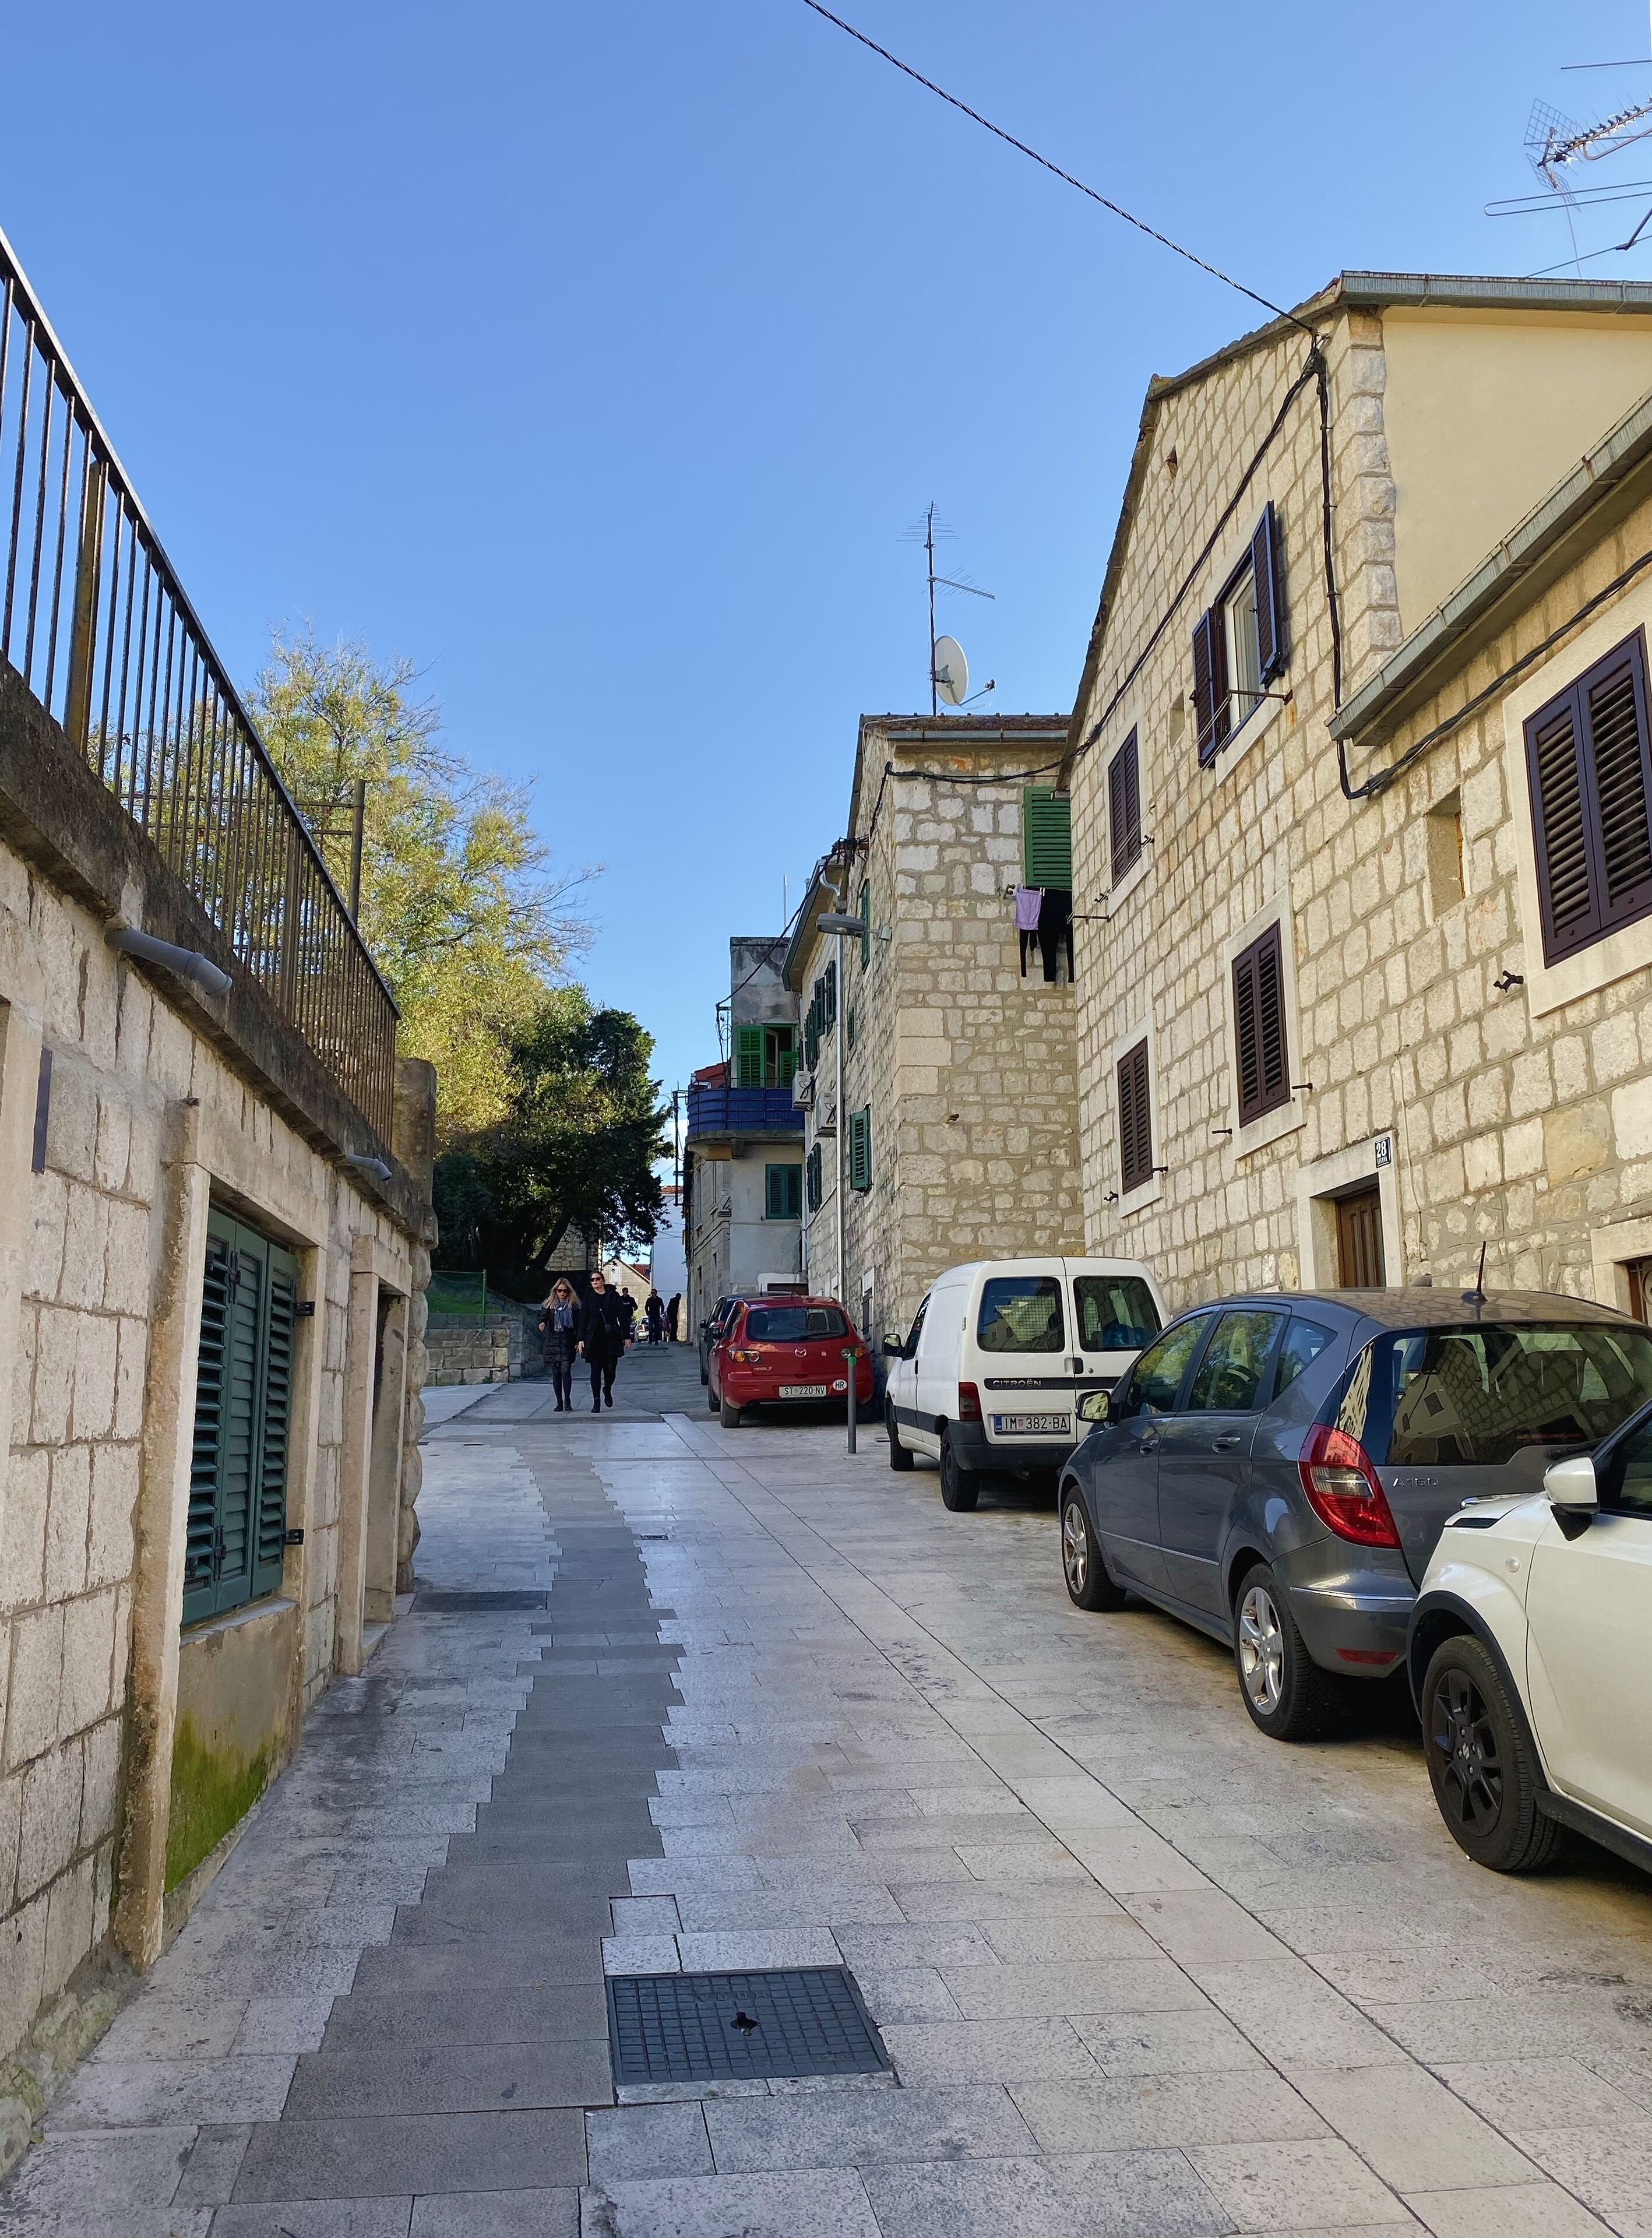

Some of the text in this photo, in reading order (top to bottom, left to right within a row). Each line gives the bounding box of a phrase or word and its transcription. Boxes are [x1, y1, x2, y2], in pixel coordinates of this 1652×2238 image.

[1376, 1141, 1387, 1158] 28
[992, 1378, 1041, 1387] CITROËN
[1005, 1417, 1067, 1429] IM 382-BA
